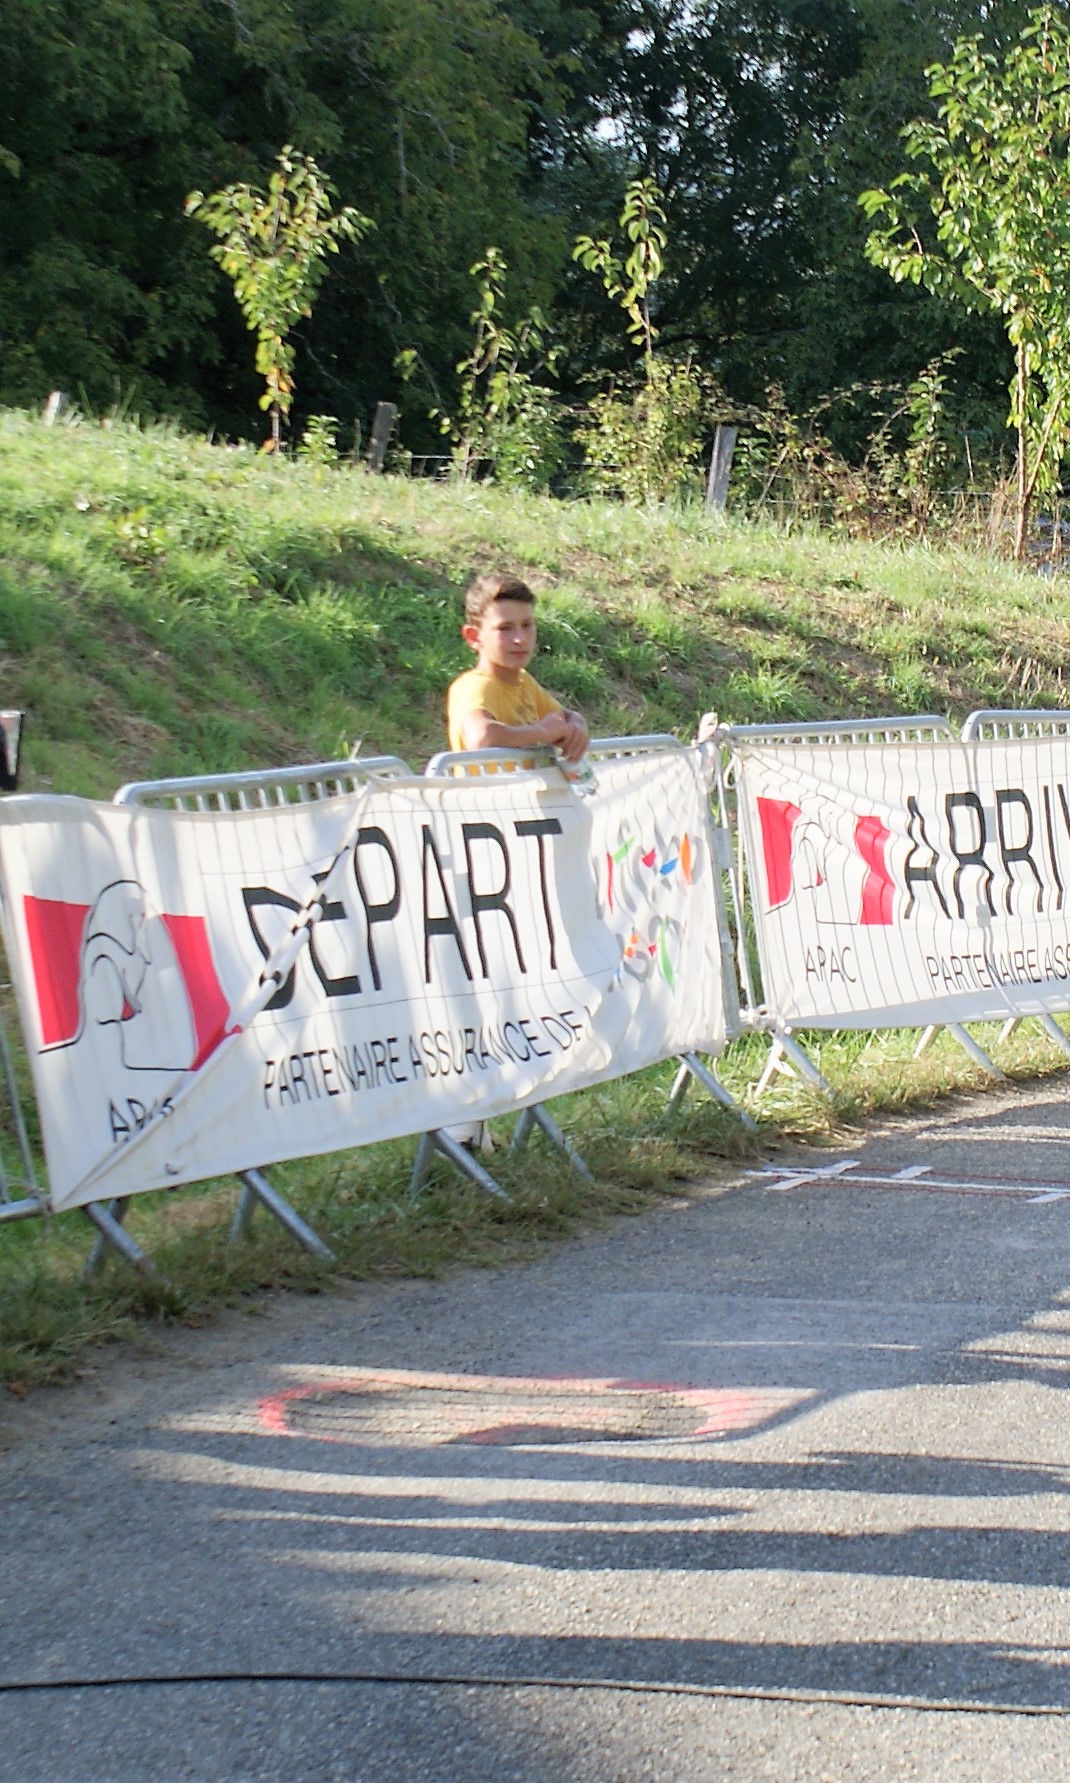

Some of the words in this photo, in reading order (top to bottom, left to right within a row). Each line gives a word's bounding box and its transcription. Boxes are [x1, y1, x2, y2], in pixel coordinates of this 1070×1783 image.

[241, 817, 563, 1011] DEPART
[805, 944, 857, 984] APAC
[926, 946, 1043, 993] PARTENAIRE
[263, 1035, 408, 1109] PARTENAIRE
[409, 1019, 552, 1077] ASSURANCE
[108, 1096, 175, 1143] AP
